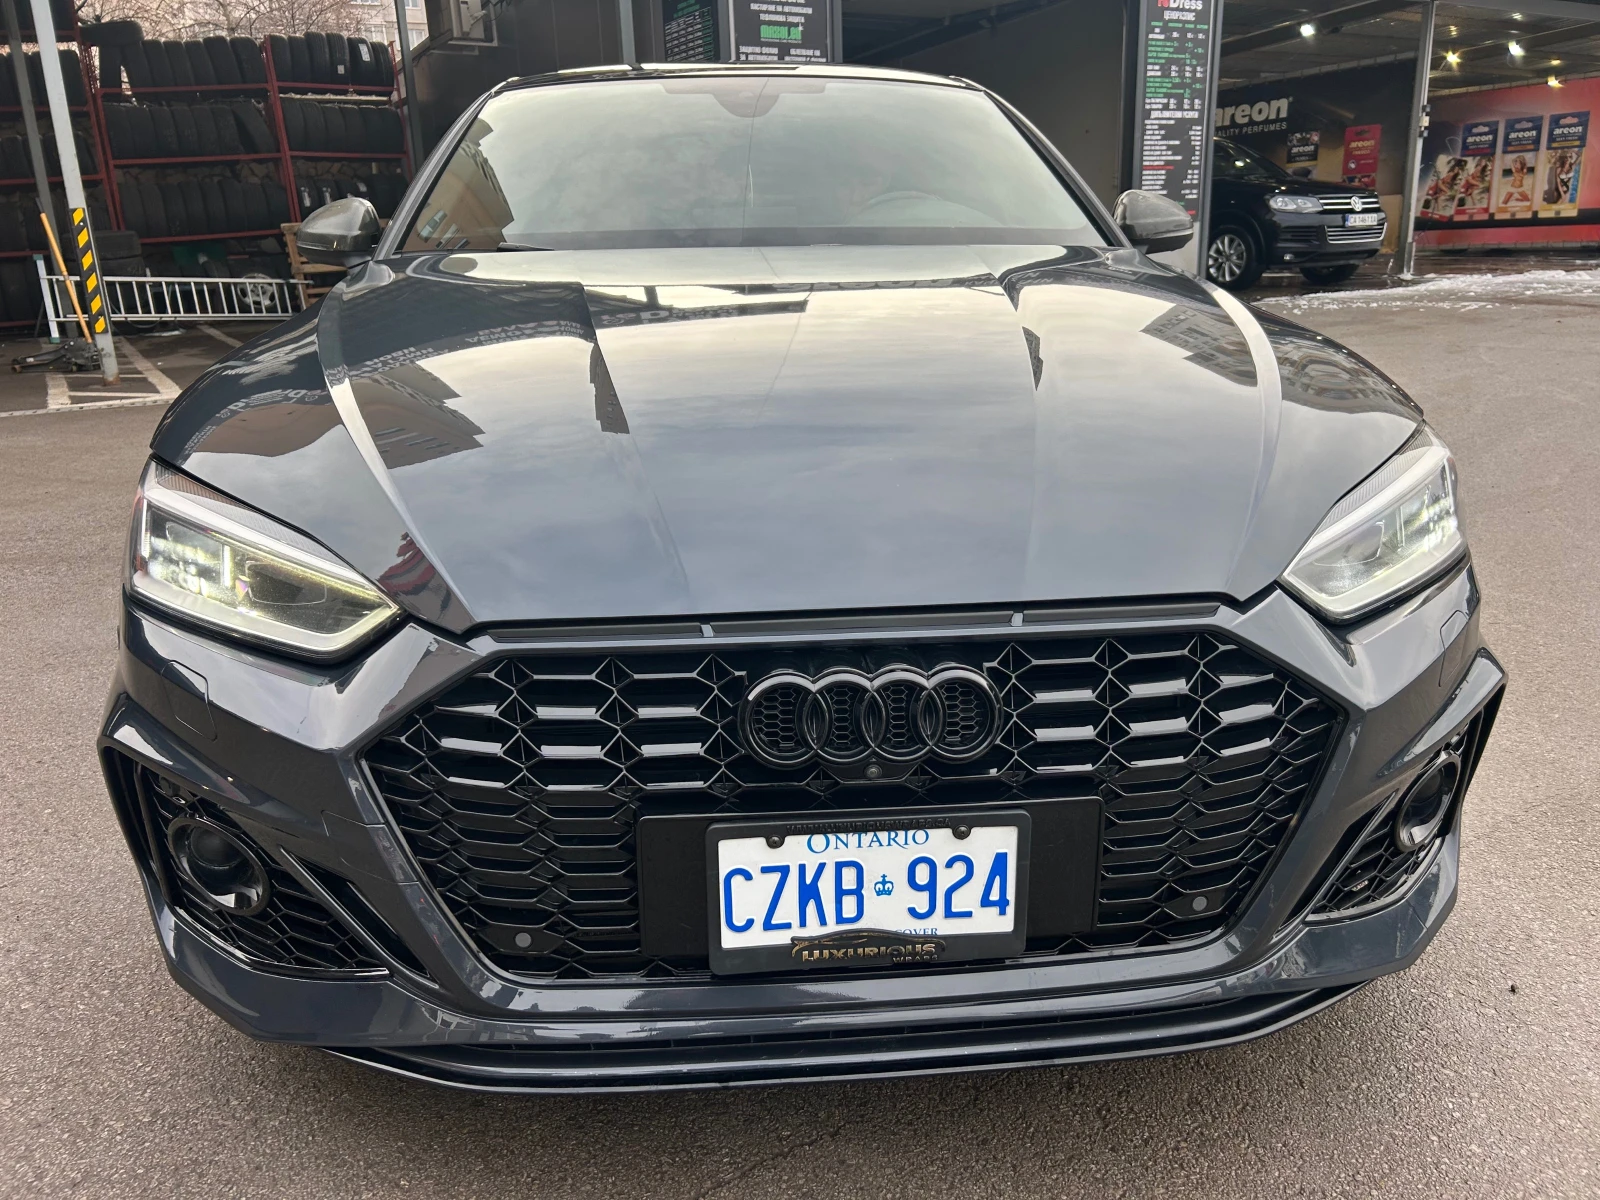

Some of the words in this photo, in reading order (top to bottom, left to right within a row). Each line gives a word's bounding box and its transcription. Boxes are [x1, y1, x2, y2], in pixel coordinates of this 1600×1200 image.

[1215, 128, 1240, 137] ALITY
[1242, 121, 1288, 134] PERFUMES
[1508, 130, 1536, 138] areon
[1553, 126, 1581, 134] areon
[1349, 139, 1374, 147] areon
[1466, 134, 1492, 142] areon
[806, 828, 930, 854] ONTARIO
[723, 859, 865, 933] CZKB
[907, 851, 1010, 920] 924
[802, 943, 936, 962] LUXURIOUS
